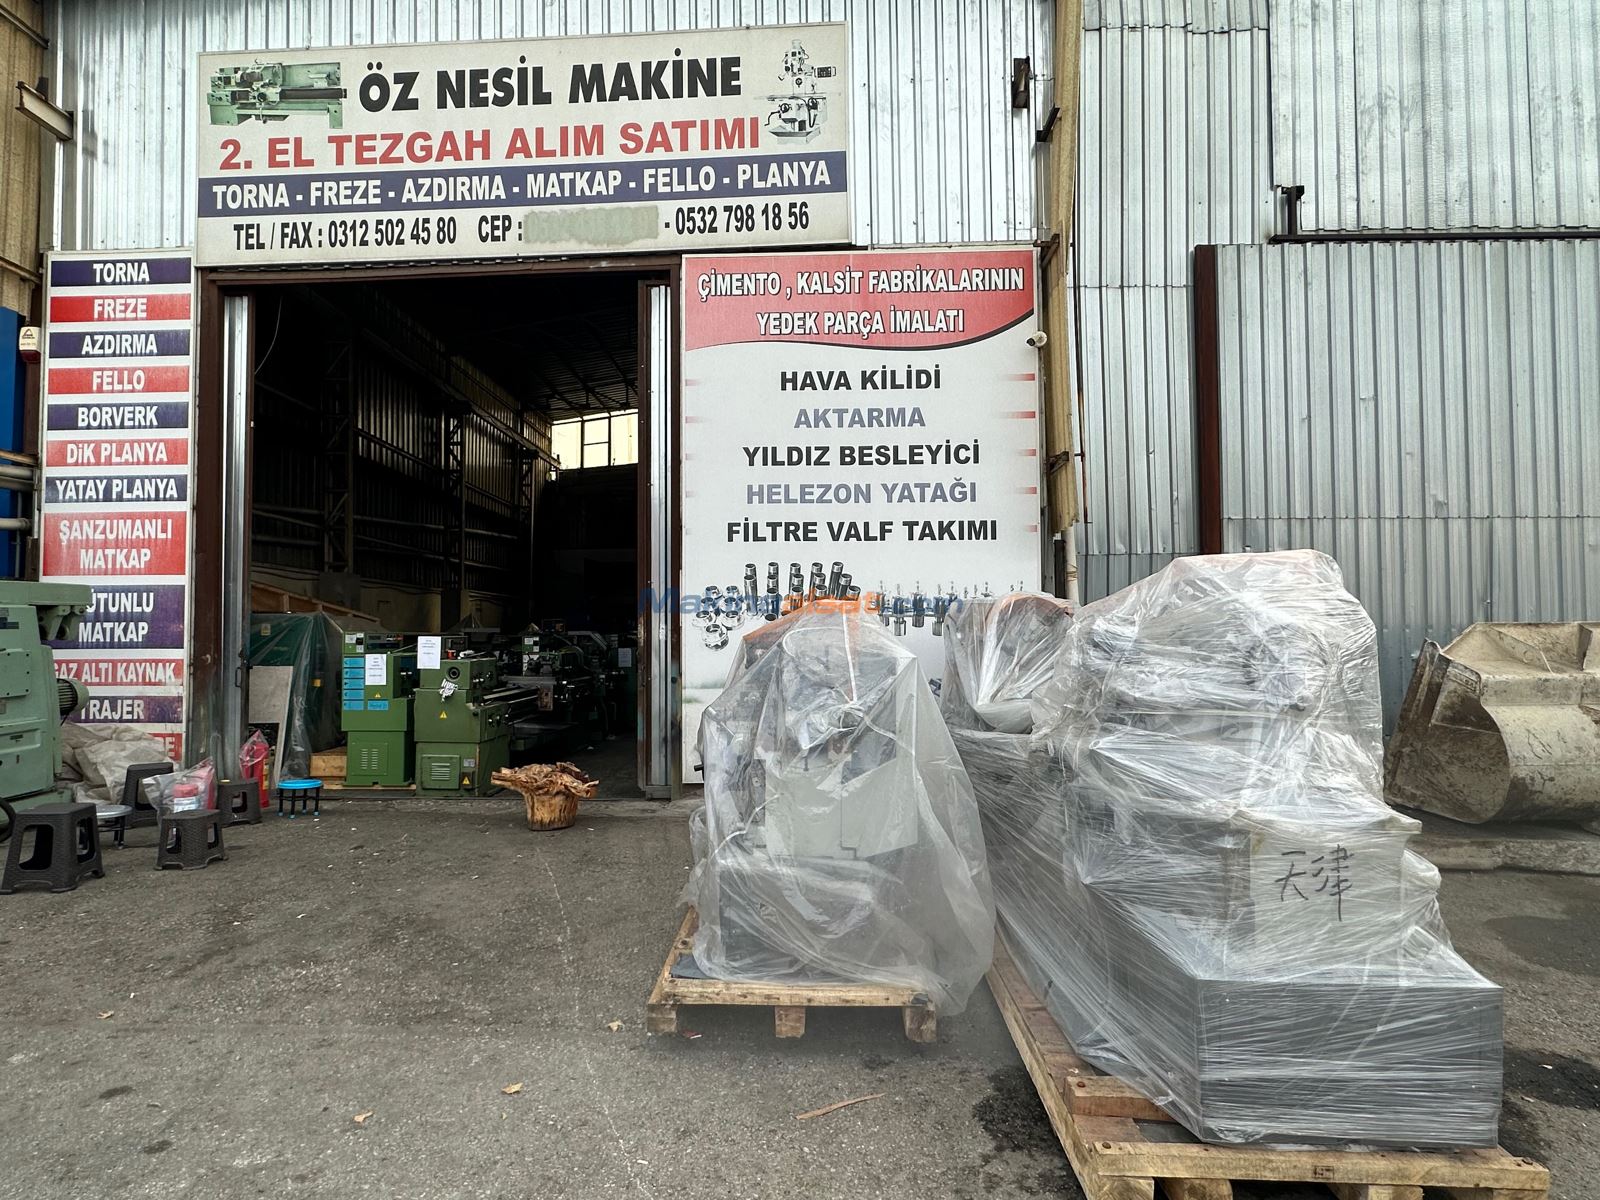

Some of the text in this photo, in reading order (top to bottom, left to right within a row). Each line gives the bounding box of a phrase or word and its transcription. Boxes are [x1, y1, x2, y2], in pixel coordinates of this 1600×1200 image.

[359, 47, 741, 112] ÖZ NESİL MAKİNE
[219, 116, 759, 170] 2. EL TEZGAH ALIM SATIMI
[212, 182, 290, 209] TORNA
[310, 179, 382, 206] FREZE
[401, 175, 506, 203] AZDIRMA
[526, 170, 622, 198] MATKAP
[643, 165, 716, 193] FELLO
[737, 160, 831, 189] PLANYA
[233, 224, 265, 250] TEL
[280, 221, 312, 249] FAX
[328, 219, 369, 248] 0312
[374, 218, 405, 246] 502
[410, 217, 430, 245] 45
[437, 216, 457, 245] 80
[478, 214, 512, 243] CEP
[675, 206, 718, 235] 0532
[724, 204, 755, 232] 798
[761, 203, 782, 231] 18
[788, 201, 809, 230] 56
[93, 262, 150, 283] TORNA
[697, 268, 781, 301] ÇİMENTO
[797, 265, 864, 295] KALSİT
[868, 264, 1025, 294] FABRİKALARININ
[93, 298, 147, 319] FREZE
[756, 305, 965, 339] YEDEK PARÇA İMALATI
[81, 333, 158, 355] AZDIRMA
[92, 369, 145, 391] FELLO
[780, 363, 942, 391] HAVA KİLİDİ
[77, 405, 158, 428] BORVERK
[793, 407, 926, 429] AKTARMA
[101, 442, 168, 464] PLANYA
[742, 439, 980, 467] YILDIZ BESLEYİCİ
[56, 478, 178, 500] YATAY PLANYA
[746, 477, 977, 505] HELEZON YATAĞI
[59, 519, 172, 544] ŞANZUMANLI
[727, 517, 998, 543] FİLTRE VALF TAKIMI
[80, 549, 151, 569] MATKAP
[78, 622, 149, 643] MATKAP
[81, 662, 113, 683] ALTI
[117, 662, 176, 683] KAYNAK
[1275, 844, 1355, 921] 天津
